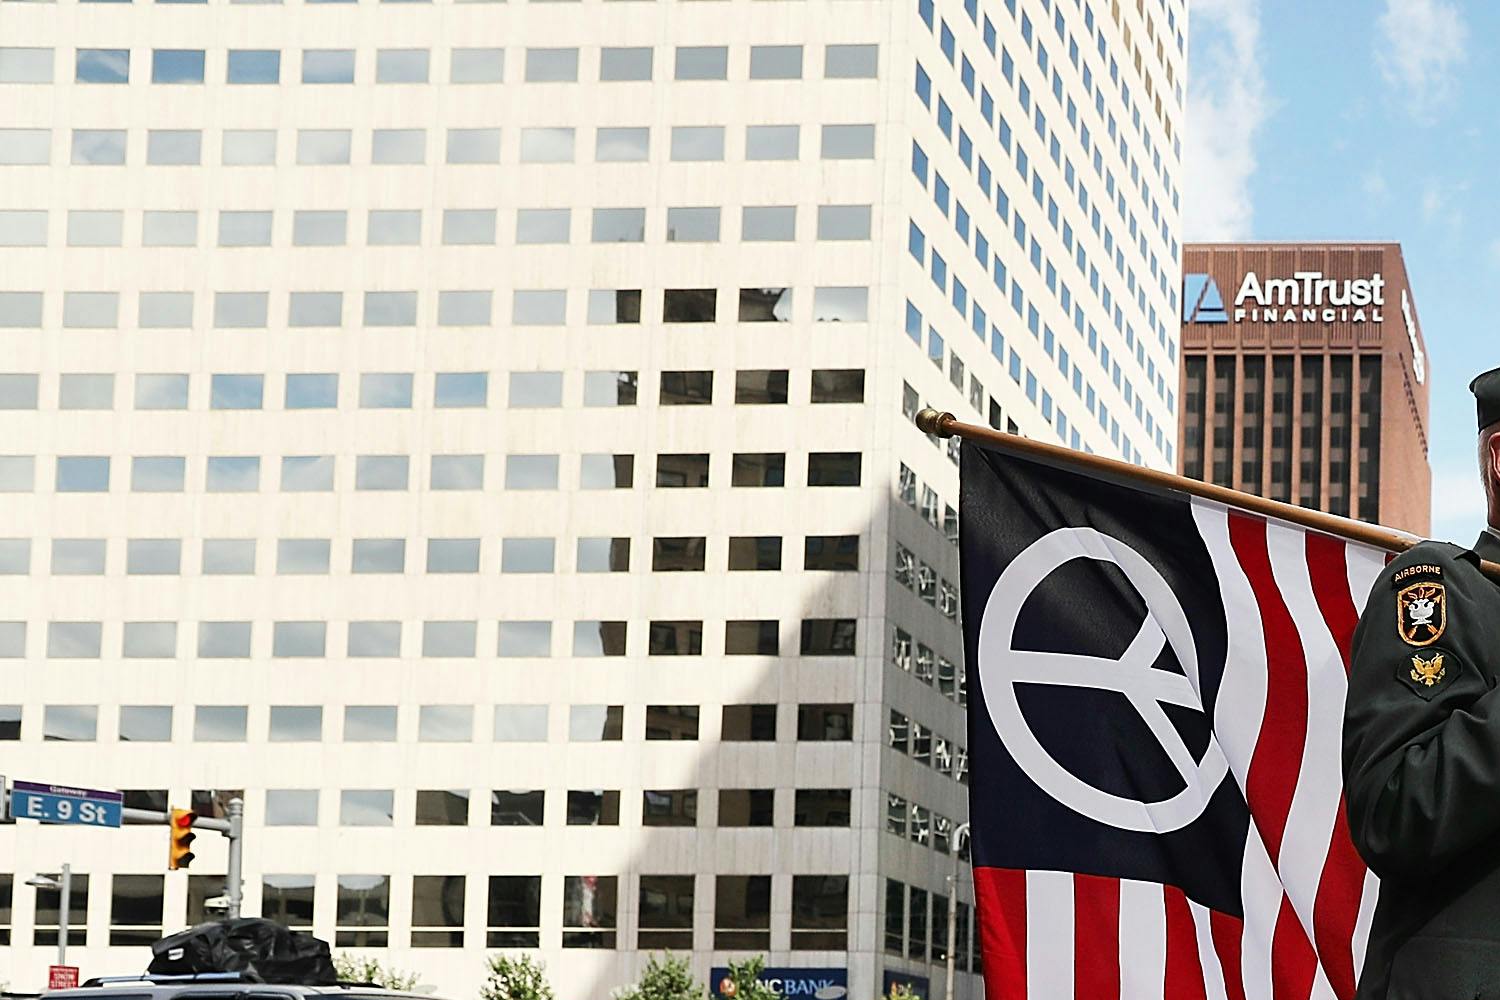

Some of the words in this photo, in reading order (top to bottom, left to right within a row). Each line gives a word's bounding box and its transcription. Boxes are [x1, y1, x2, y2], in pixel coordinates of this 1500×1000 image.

[1234, 271, 1385, 306] AmTrust
[1234, 308, 1384, 322] FINANCIAL
[1394, 564, 1441, 582] AIRBORNE
[27, 795, 49, 818] E.
[56, 800, 73, 820] 9
[78, 802, 107, 825] St
